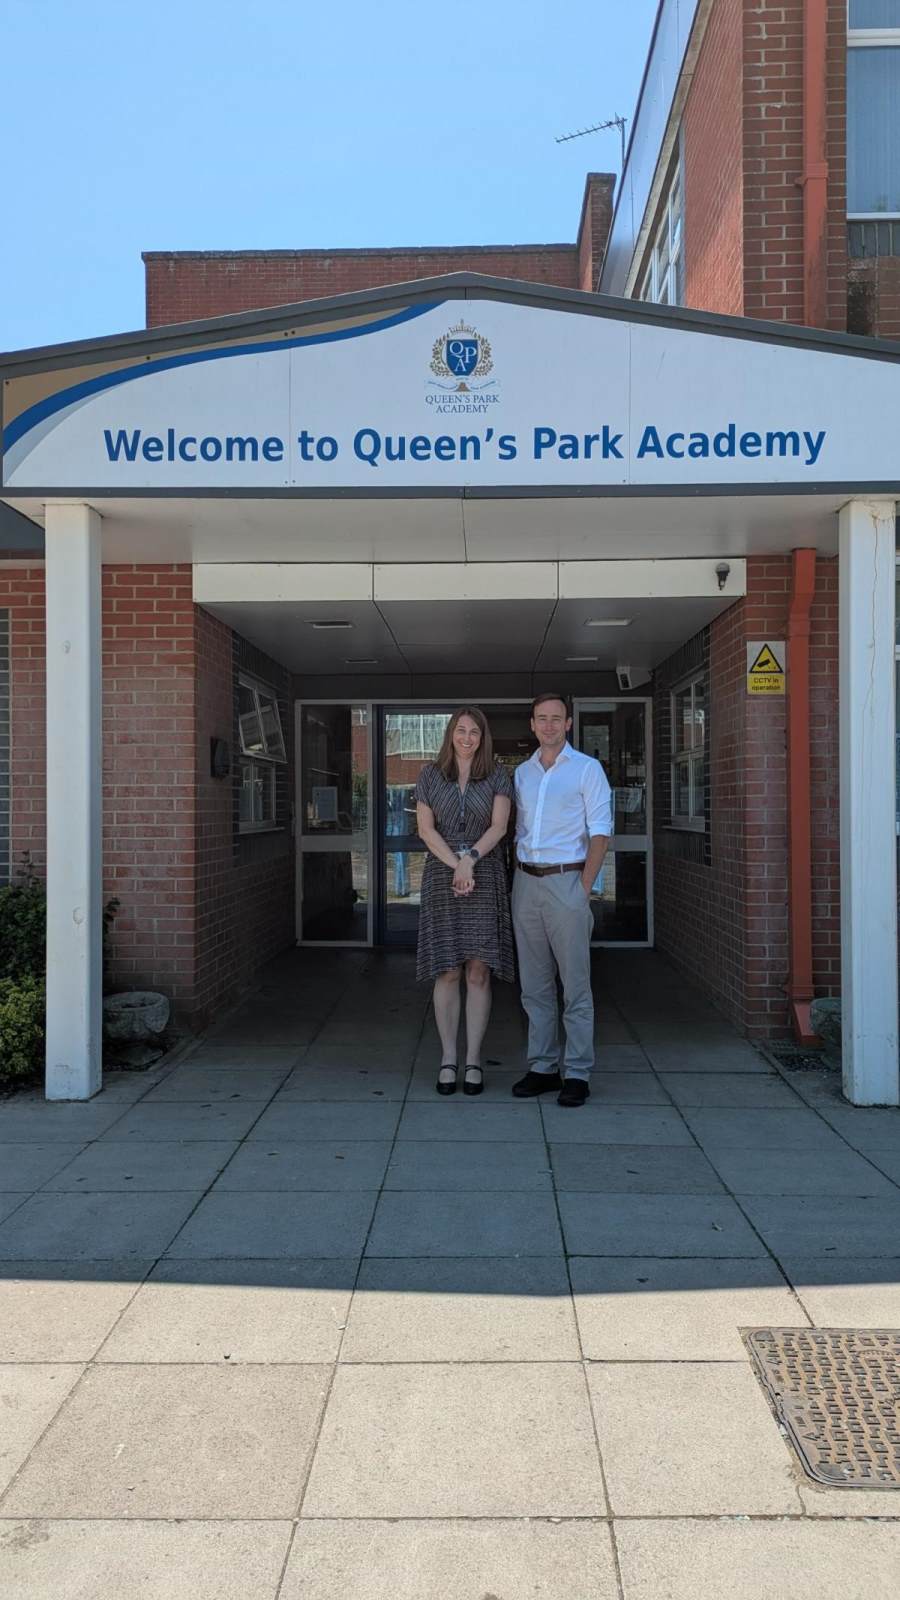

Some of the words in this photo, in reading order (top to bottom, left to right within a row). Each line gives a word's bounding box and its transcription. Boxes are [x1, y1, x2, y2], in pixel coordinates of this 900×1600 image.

[425, 394, 471, 404] QUEEN'S
[473, 394, 501, 403] PARK
[436, 404, 489, 413] ACADEMY
[103, 428, 285, 463] Welcome
[297, 430, 339, 462] to
[353, 427, 518, 468] Queen's
[533, 425, 624, 460] Park
[636, 423, 827, 466] Academy
